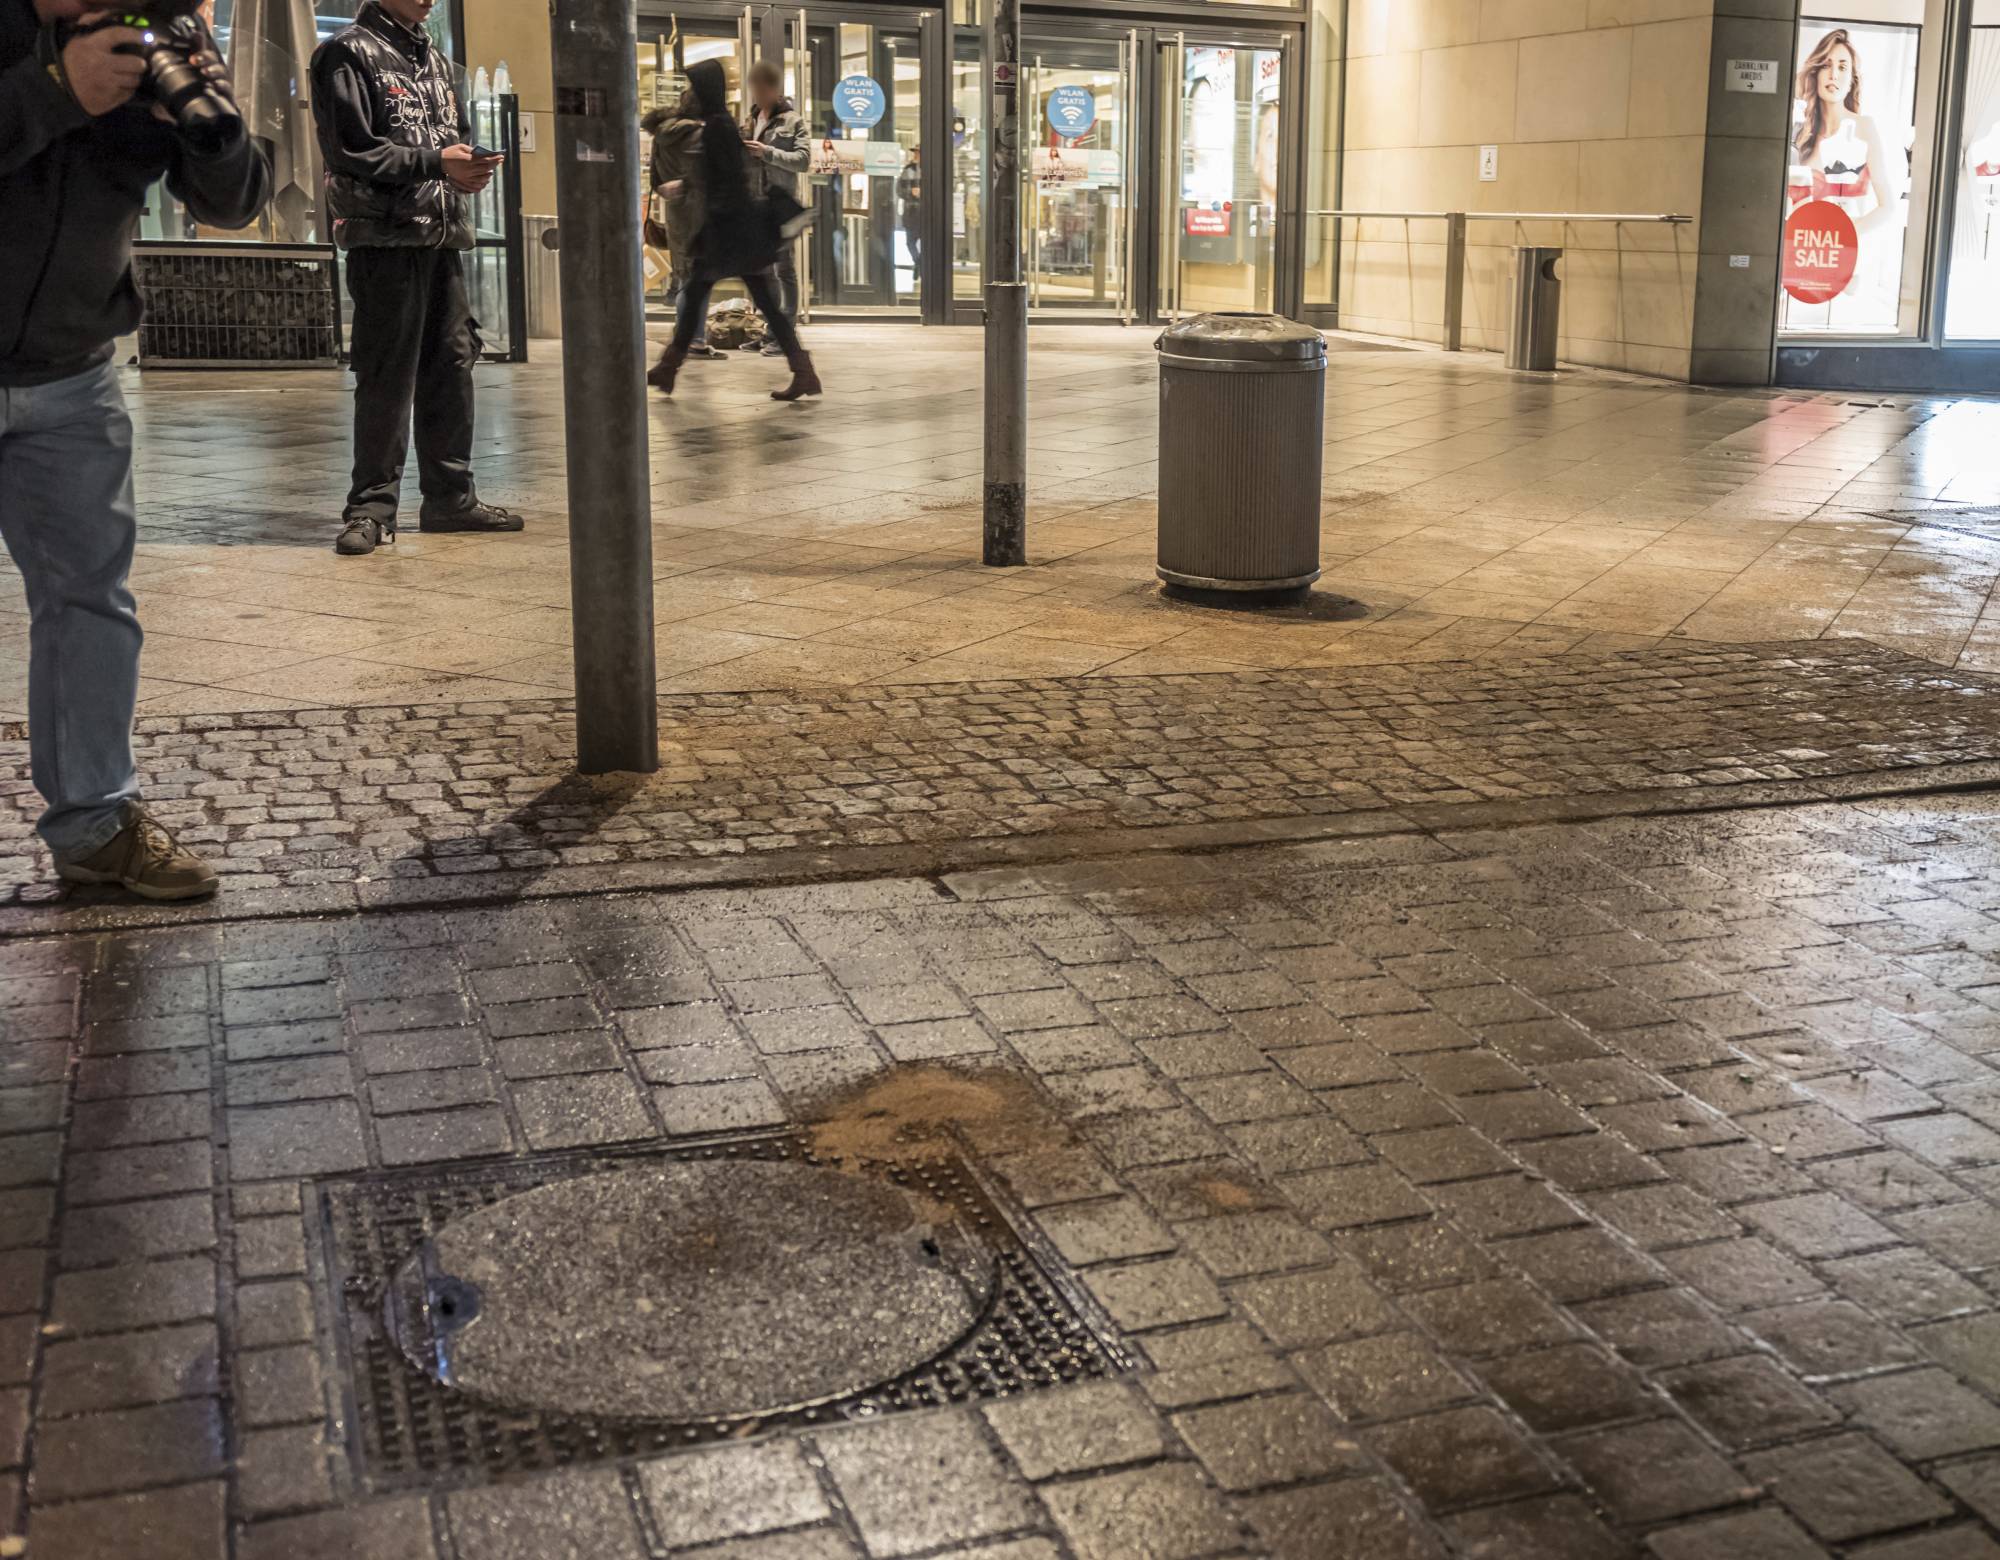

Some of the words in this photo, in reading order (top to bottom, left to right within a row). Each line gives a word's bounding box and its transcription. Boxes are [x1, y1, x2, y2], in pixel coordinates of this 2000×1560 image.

[846, 80, 873, 89] WLAN
[843, 88, 875, 97] GRATIS
[1058, 89, 1085, 98] WLAN
[1056, 97, 1087, 106] GRATIS
[1793, 229, 1844, 249] FINAL
[1794, 249, 1840, 269] SALE
